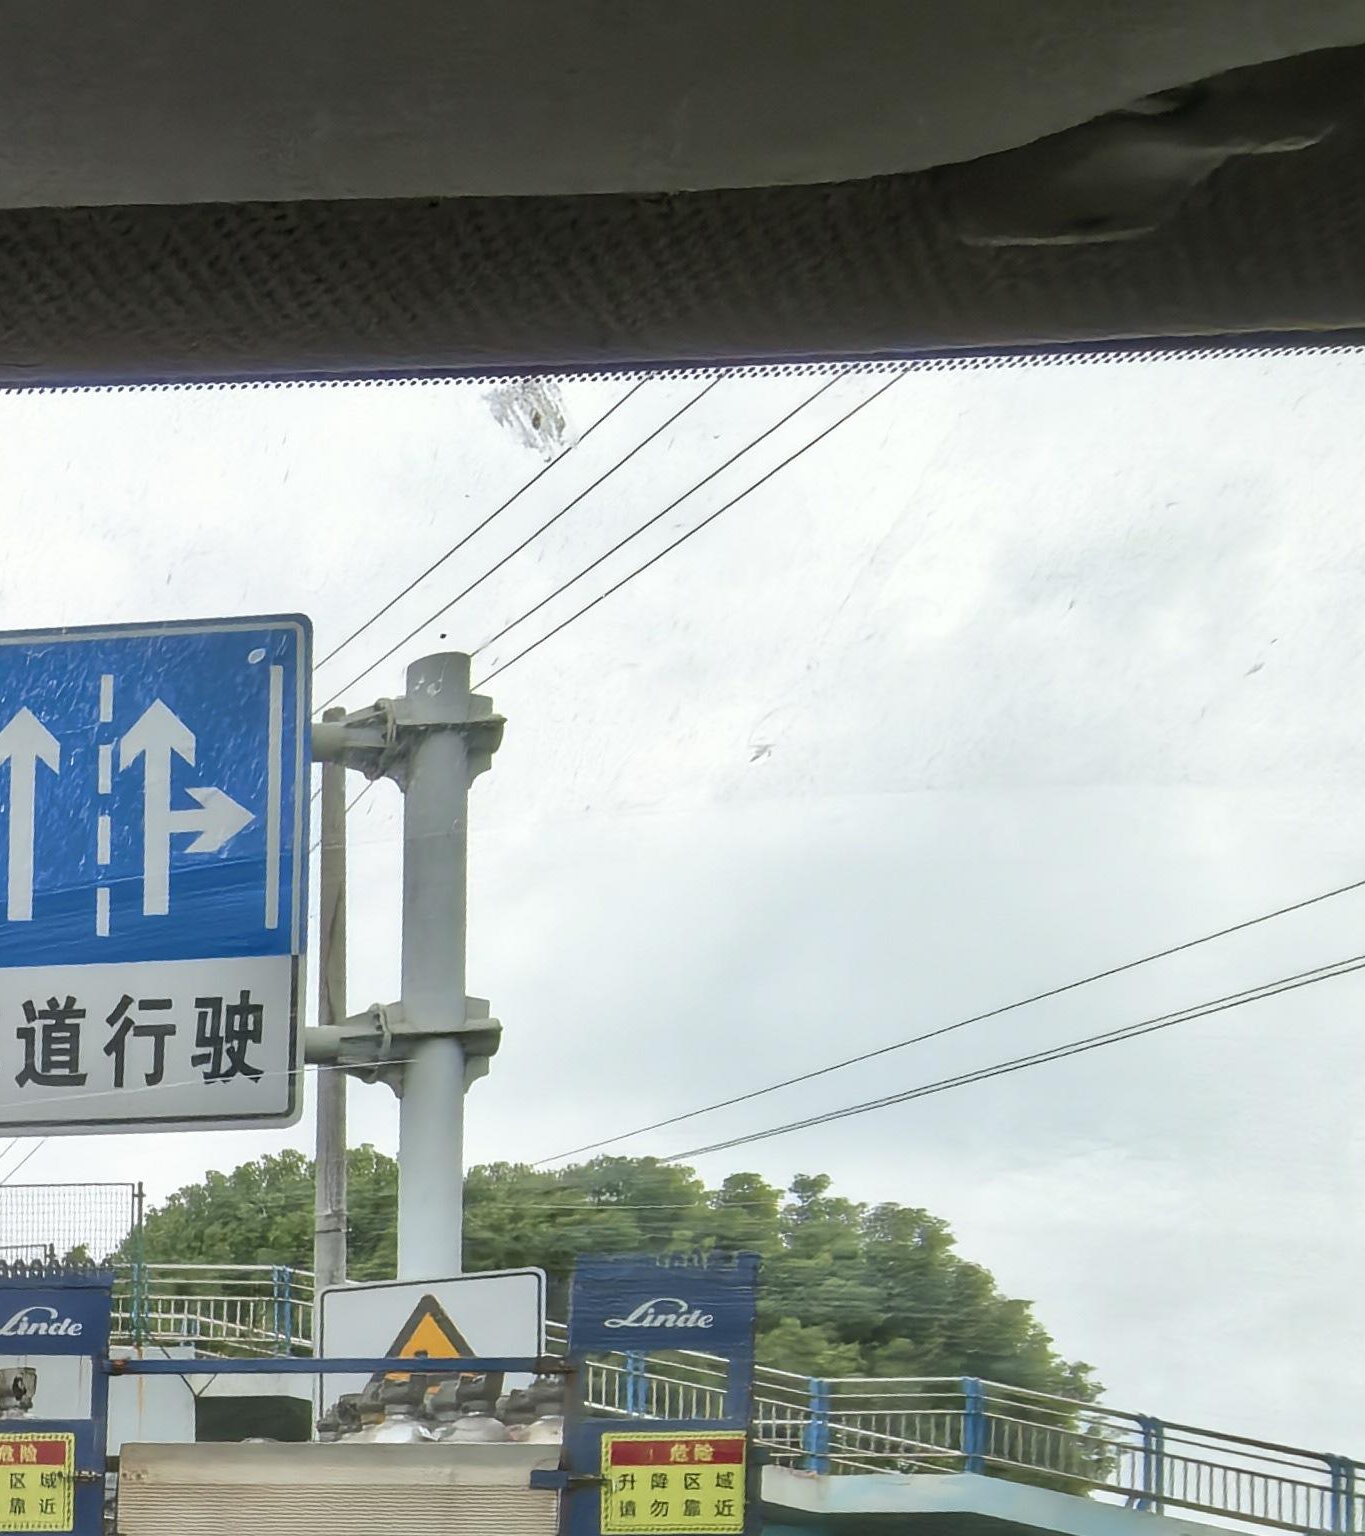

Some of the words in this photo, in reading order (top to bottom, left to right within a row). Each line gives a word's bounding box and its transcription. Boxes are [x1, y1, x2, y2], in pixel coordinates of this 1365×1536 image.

[604, 1298, 714, 1329] Linde
[670, 1443, 714, 1463] 危险
[620, 1499, 736, 1518] 请勿靠近
